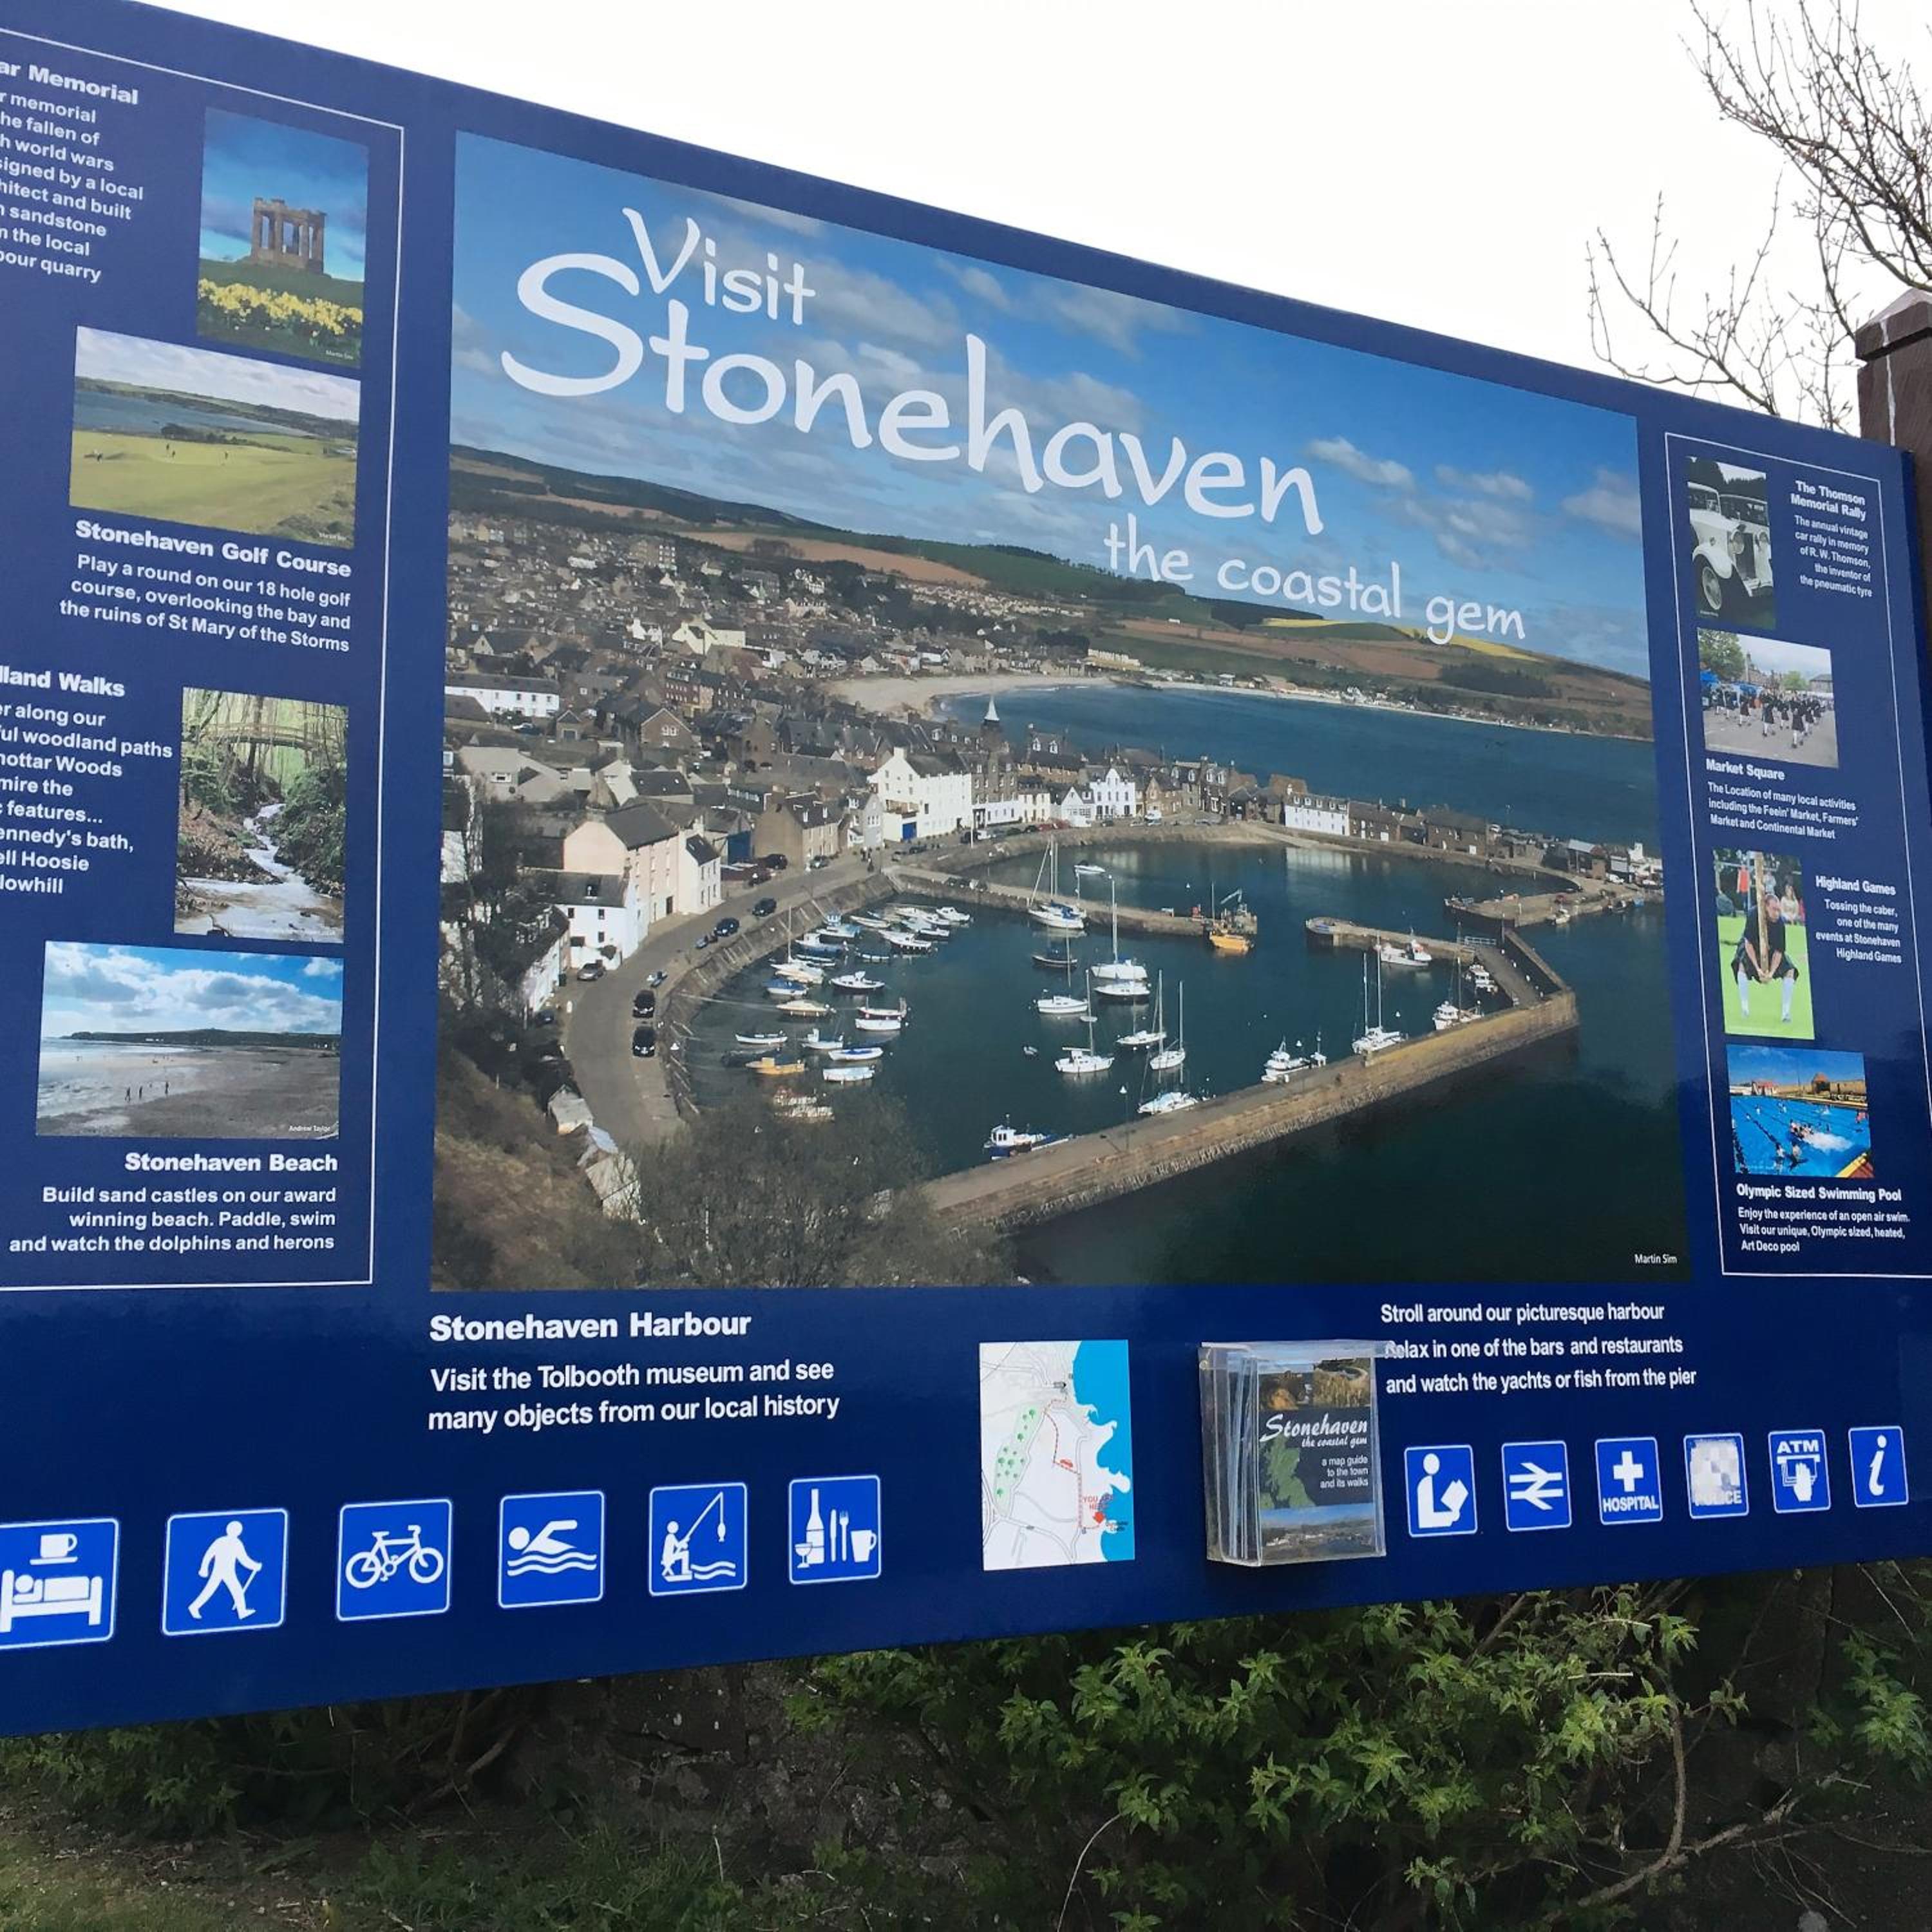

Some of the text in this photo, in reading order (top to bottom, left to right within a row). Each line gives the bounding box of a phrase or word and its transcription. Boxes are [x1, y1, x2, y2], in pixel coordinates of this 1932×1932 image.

[29, 64, 138, 104] Memorial
[10, 95, 96, 123] memorial
[26, 117, 77, 141] fallen
[81, 132, 100, 146] of
[15, 140, 66, 160] world
[71, 152, 114, 171] wars
[59, 169, 143, 200] by a local
[52, 193, 131, 220] and built
[10, 207, 106, 236] sandstone
[12, 228, 41, 245] the
[46, 234, 90, 256] local
[41, 260, 101, 283] quarry
[621, 207, 816, 326] Visit
[500, 252, 1324, 535] Stonehaven
[1795, 480, 1865, 506] The Thomson
[1791, 493, 1866, 522] Memorial Rally
[75, 520, 351, 577] Stonehaven Golf Course
[1795, 532, 1869, 555] car rally in memory
[78, 554, 350, 607] Play a round on our 18 hole golf
[1103, 513, 1526, 645] the coastal gem
[71, 580, 350, 629] course, overlooking the bay and
[60, 600, 349, 652] the ruins of St Mary of the Storms
[59, 672, 125, 697] Walks
[15, 703, 106, 726] along our
[23, 732, 173, 757] woodland paths
[55, 755, 122, 777] Woods
[1706, 758, 1785, 780] Market Square
[43, 779, 73, 796] the
[1708, 781, 1856, 811] The Location of many local activities
[6, 800, 102, 823] features...
[86, 831, 133, 853] bath,
[22, 851, 89, 871] Hoosie
[1815, 875, 1896, 895] Highland Games
[1824, 899, 1898, 917] Tossing the caber,
[1836, 947, 1902, 963] Highland Games
[125, 1152, 337, 1171] Stonehaven Beach
[43, 1187, 336, 1203] Build sand castles on our award
[1736, 1183, 1902, 1203] Olympic Sized Swimming Pool
[70, 1211, 335, 1230] winning beach. Paddle, swim
[10, 1235, 334, 1254] and watch the dolphins and herons
[1741, 1240, 1800, 1254] Art Deco pool
[1634, 1254, 1677, 1264] Martin Sim
[1381, 1302, 1665, 1325] Stroll around our picturesque harbour
[430, 1312, 752, 1341] Stonehaven Harbour
[1385, 1336, 1683, 1359] Relax in one of the bars and restaurants
[430, 1359, 834, 1392] Visit the Tolbooth museum and see
[1386, 1367, 1696, 1394] and watch the yachts or fish from the pier
[429, 1394, 840, 1434] many objects from our local history
[1259, 1412, 1367, 1443] Stonehaven
[1302, 1435, 1367, 1448] the coastal gem
[1777, 1439, 1819, 1454] ATM
[1329, 1457, 1345, 1467] map
[1347, 1455, 1368, 1466] guide
[1603, 1495, 1659, 1513] HOSPITAL
